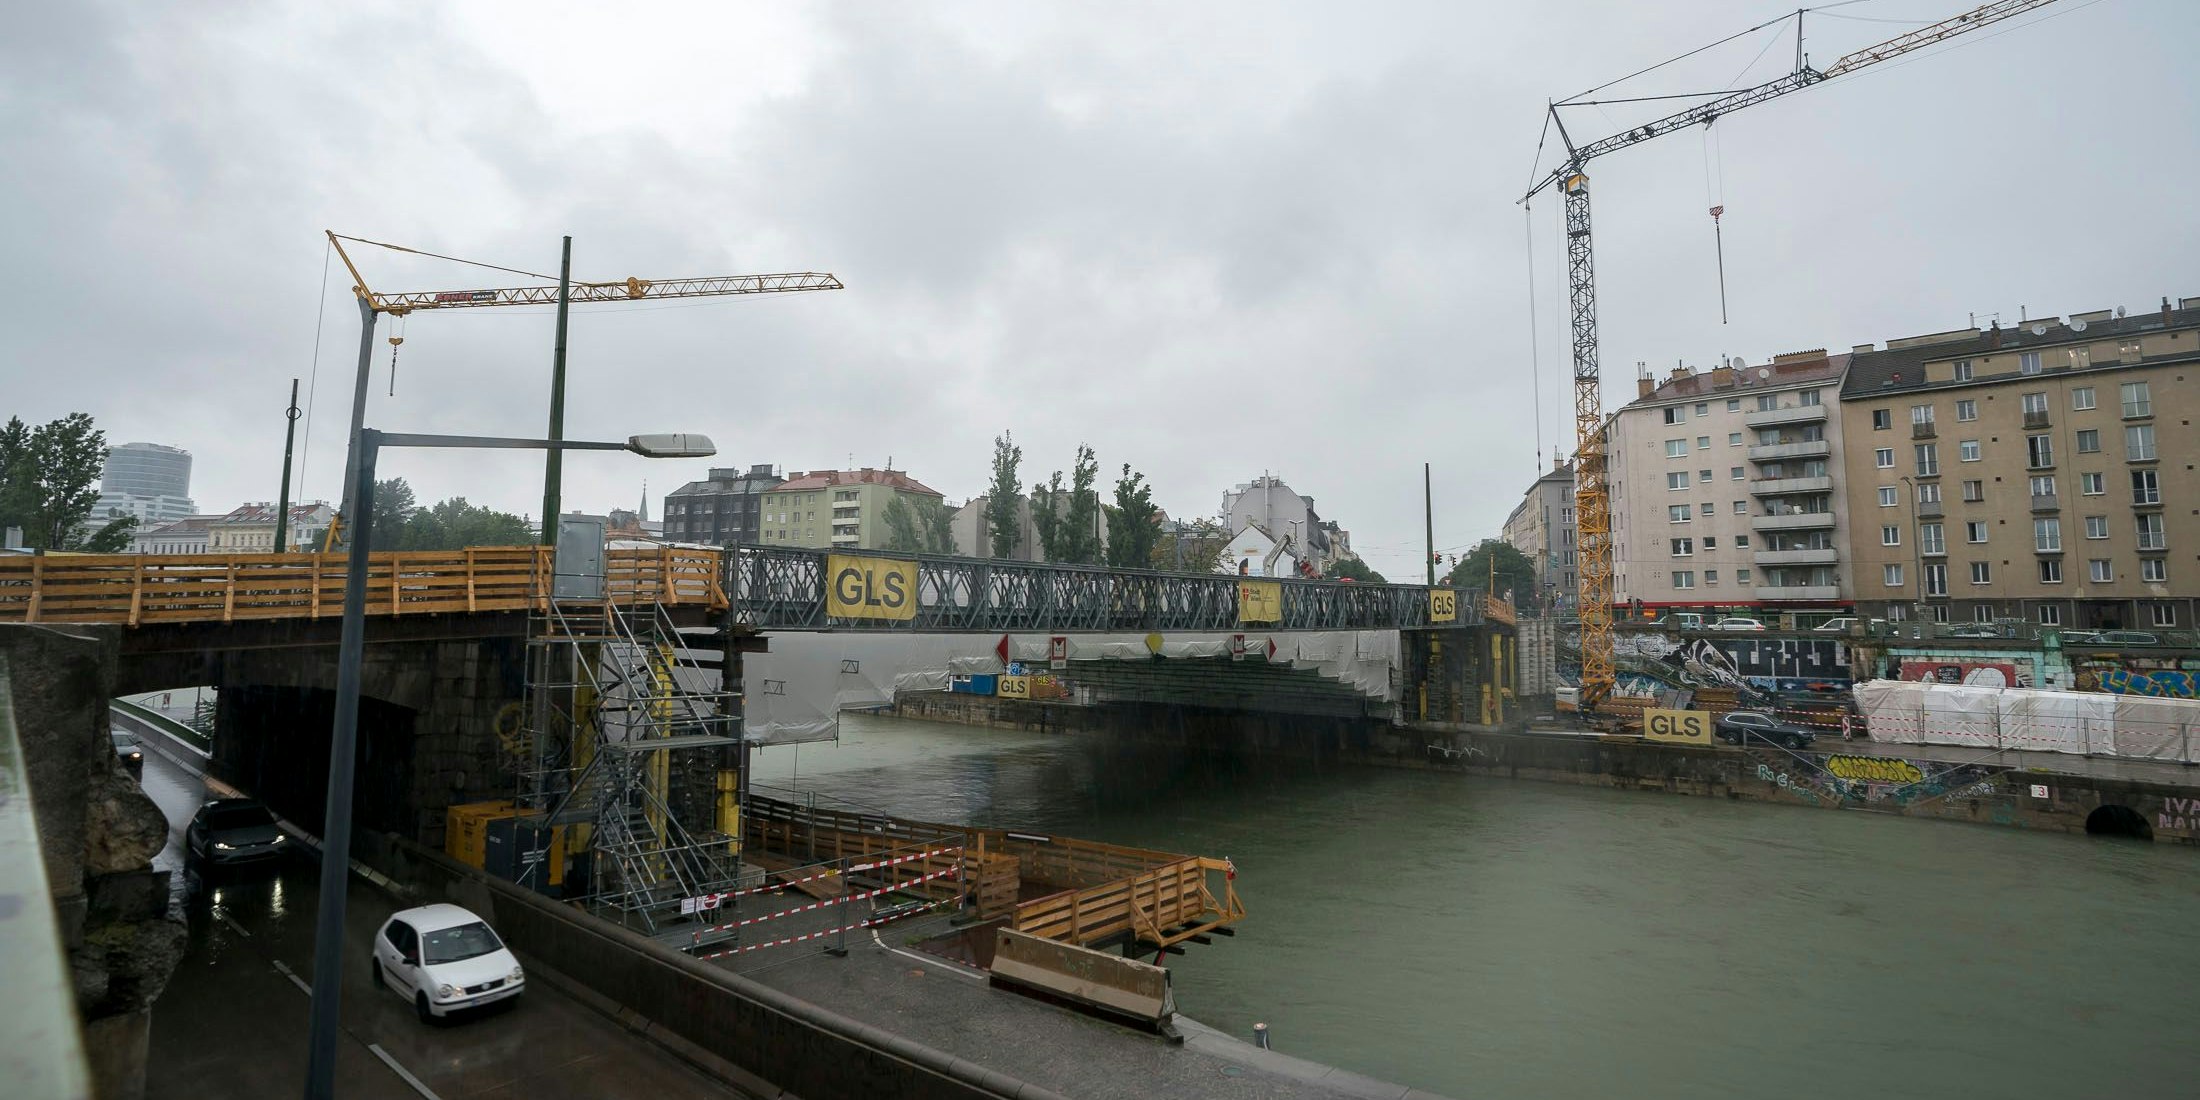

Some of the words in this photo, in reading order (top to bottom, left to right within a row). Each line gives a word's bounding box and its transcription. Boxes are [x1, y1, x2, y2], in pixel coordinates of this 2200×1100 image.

[836, 568, 905, 608] GLS
[1433, 596, 1453, 615] GLS
[1001, 680, 1026, 693] GLS
[1651, 715, 1701, 737] GLS
[2038, 786, 2045, 797] 3
